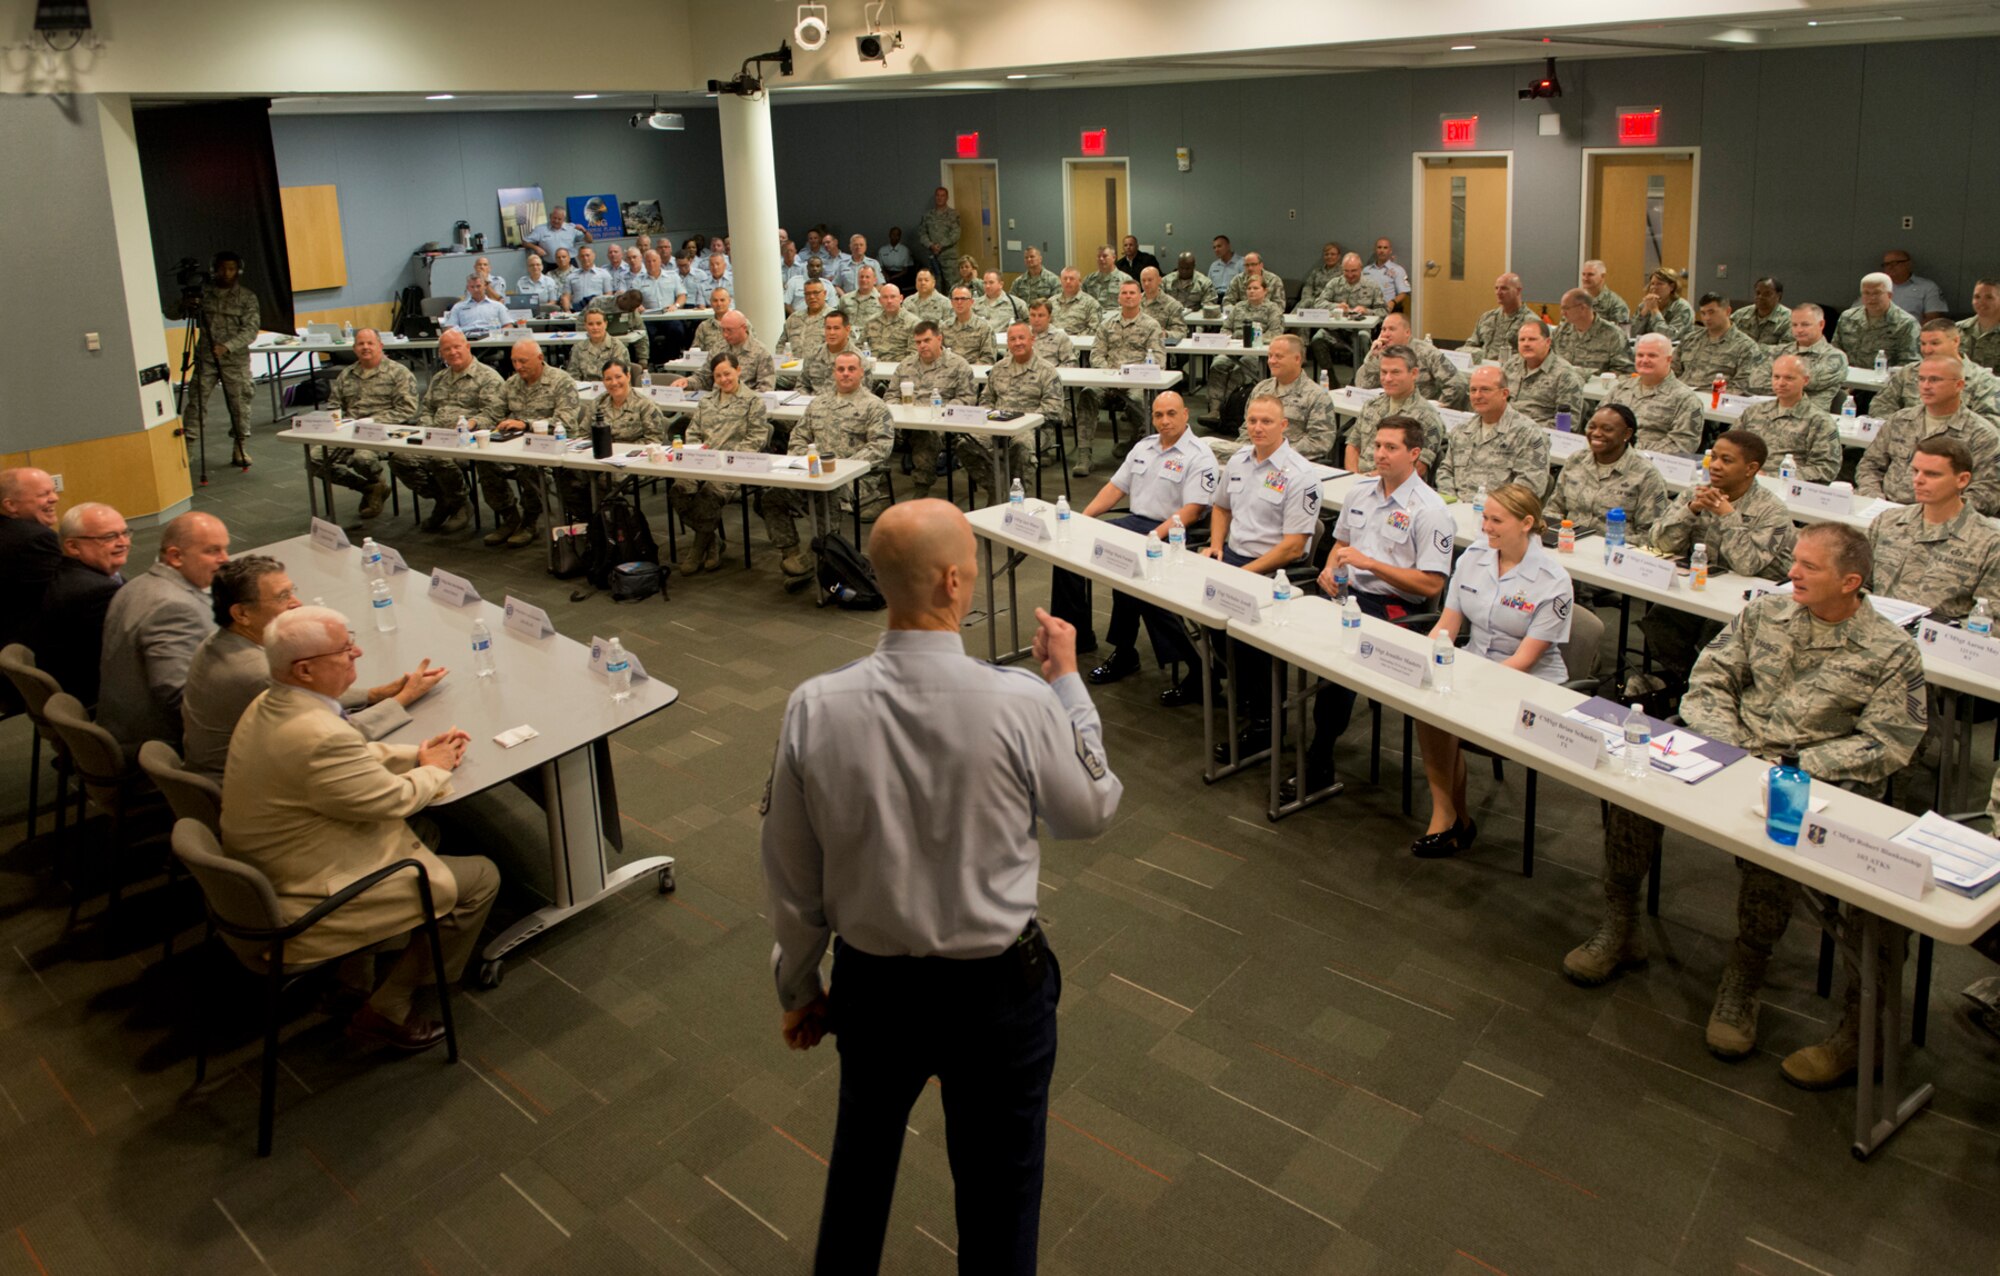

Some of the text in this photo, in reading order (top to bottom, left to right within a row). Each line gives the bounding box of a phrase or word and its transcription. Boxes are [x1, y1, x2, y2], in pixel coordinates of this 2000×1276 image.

[1447, 122, 1469, 140] EXIT
[588, 219, 608, 227] ANG
[1539, 715, 1558, 727] CMSgt
[1558, 723, 1574, 733] Brian
[1833, 831, 1921, 868] CMSgt Robert Blankenship
